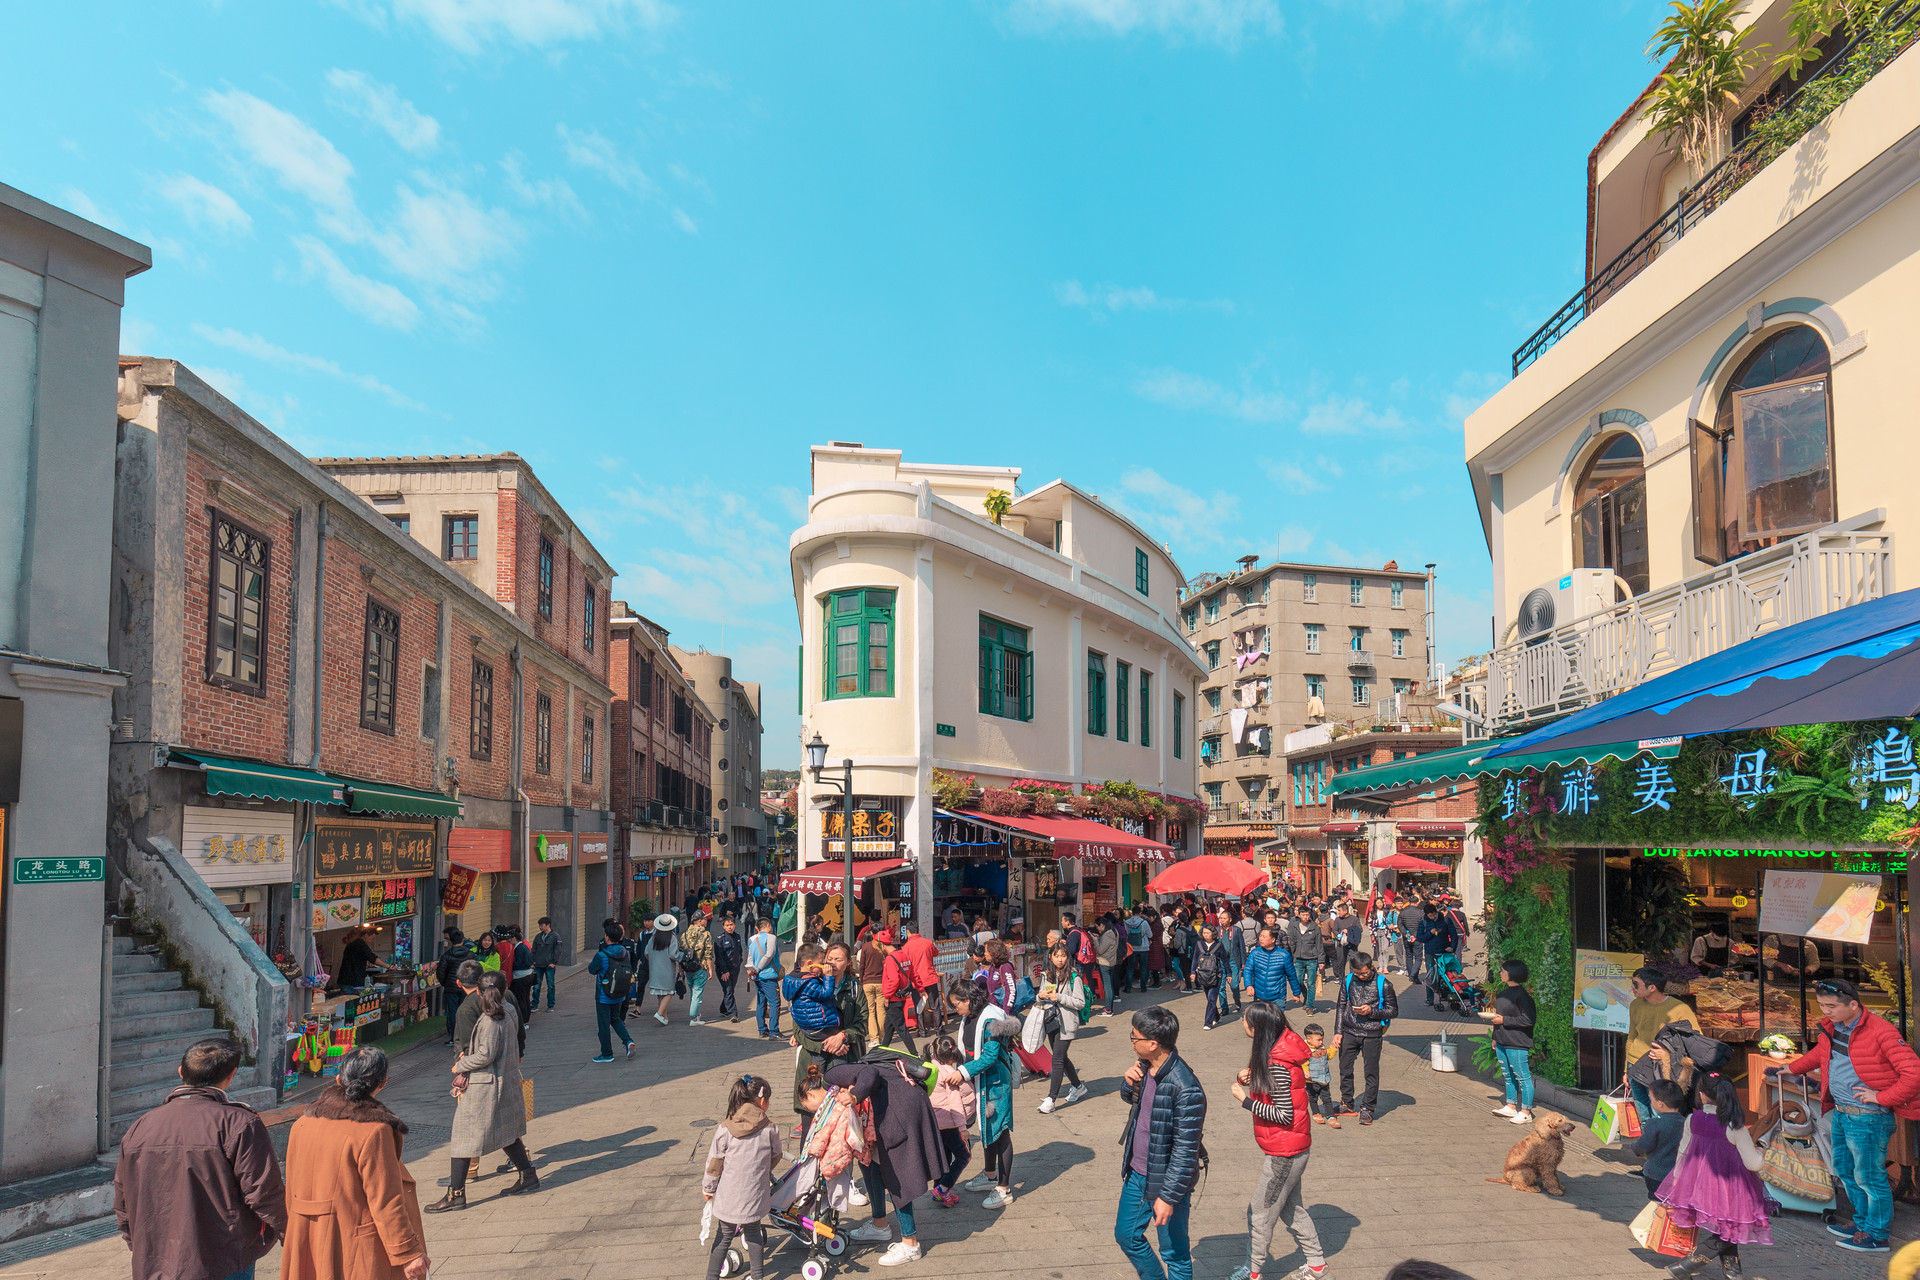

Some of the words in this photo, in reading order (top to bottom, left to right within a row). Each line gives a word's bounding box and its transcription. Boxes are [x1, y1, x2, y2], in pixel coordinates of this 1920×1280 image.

[207, 835, 286, 863] 珍珠港湾
[339, 841, 374, 861] 臭豆腐
[31, 860, 91, 871] 龙头路
[1764, 1149, 1832, 1186] BALTIMORE
